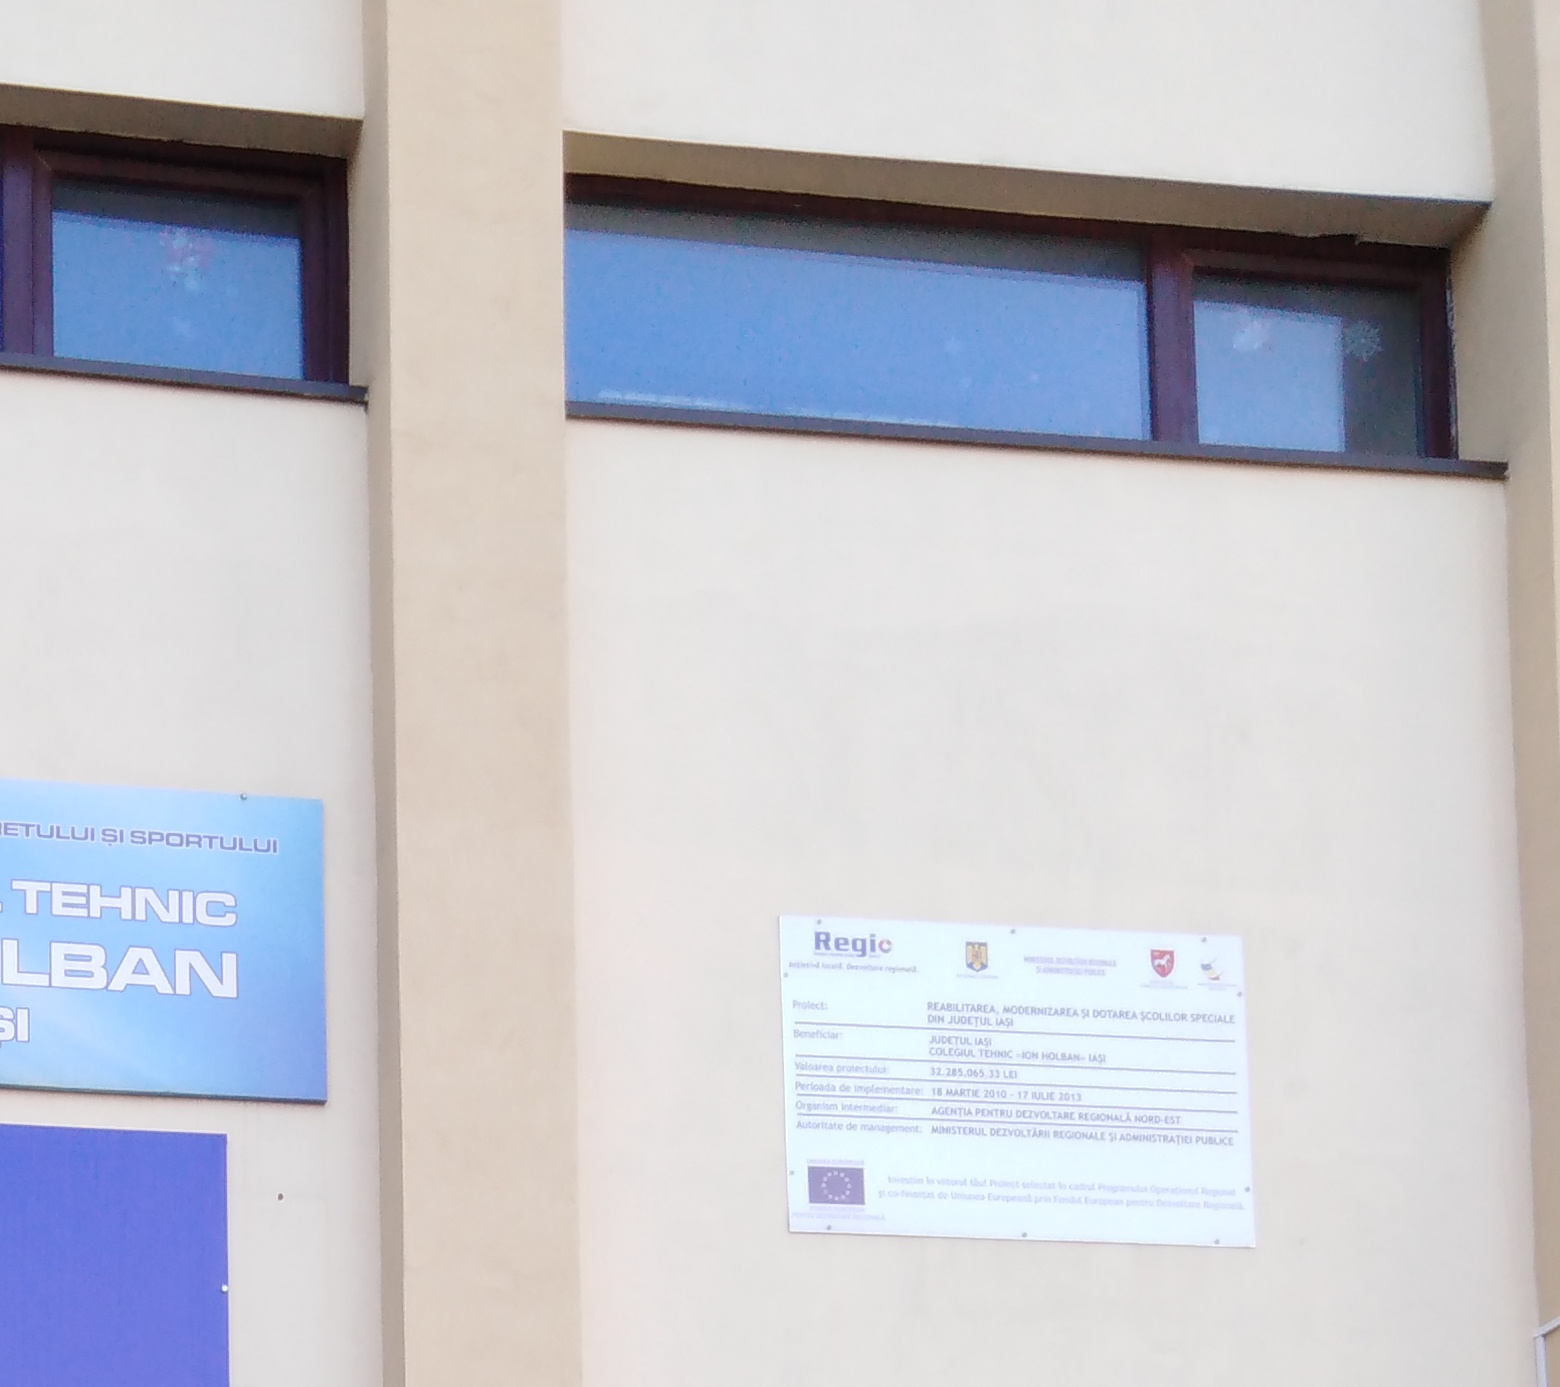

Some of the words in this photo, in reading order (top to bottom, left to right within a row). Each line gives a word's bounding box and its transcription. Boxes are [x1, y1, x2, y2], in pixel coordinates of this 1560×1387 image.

[129, 829, 279, 854] SPORTULUI
[11, 877, 238, 927] TEHNIC
[927, 1014, 944, 1024] DIN
[1002, 1004, 1078, 1018] MODERNIZAREA
[1092, 1009, 1137, 1020] DOTAREA
[1190, 1013, 1235, 1024] SPECIALE
[929, 1047, 976, 1058] COLEGIUL
[980, 1048, 1014, 1059] TEHNIC
[795, 1081, 837, 1092] Perioada
[840, 1083, 852, 1093] de
[946, 1087, 980, 1098] MARTIE
[983, 1089, 1007, 1099] 2010
[1018, 1090, 1029, 1100] 17
[1031, 1091, 1055, 1101] IULIE
[795, 1100, 839, 1112] Organism
[975, 1107, 1013, 1118] PENTRU
[1016, 1109, 1075, 1120] DEZVOLTARE
[796, 1120, 843, 1131] Autoritate
[846, 1121, 857, 1131] de
[931, 1125, 987, 1137] MINISTERUL
[1052, 1129, 1105, 1141] REGIONALE
[1195, 1135, 1234, 1146] PUBLICE
